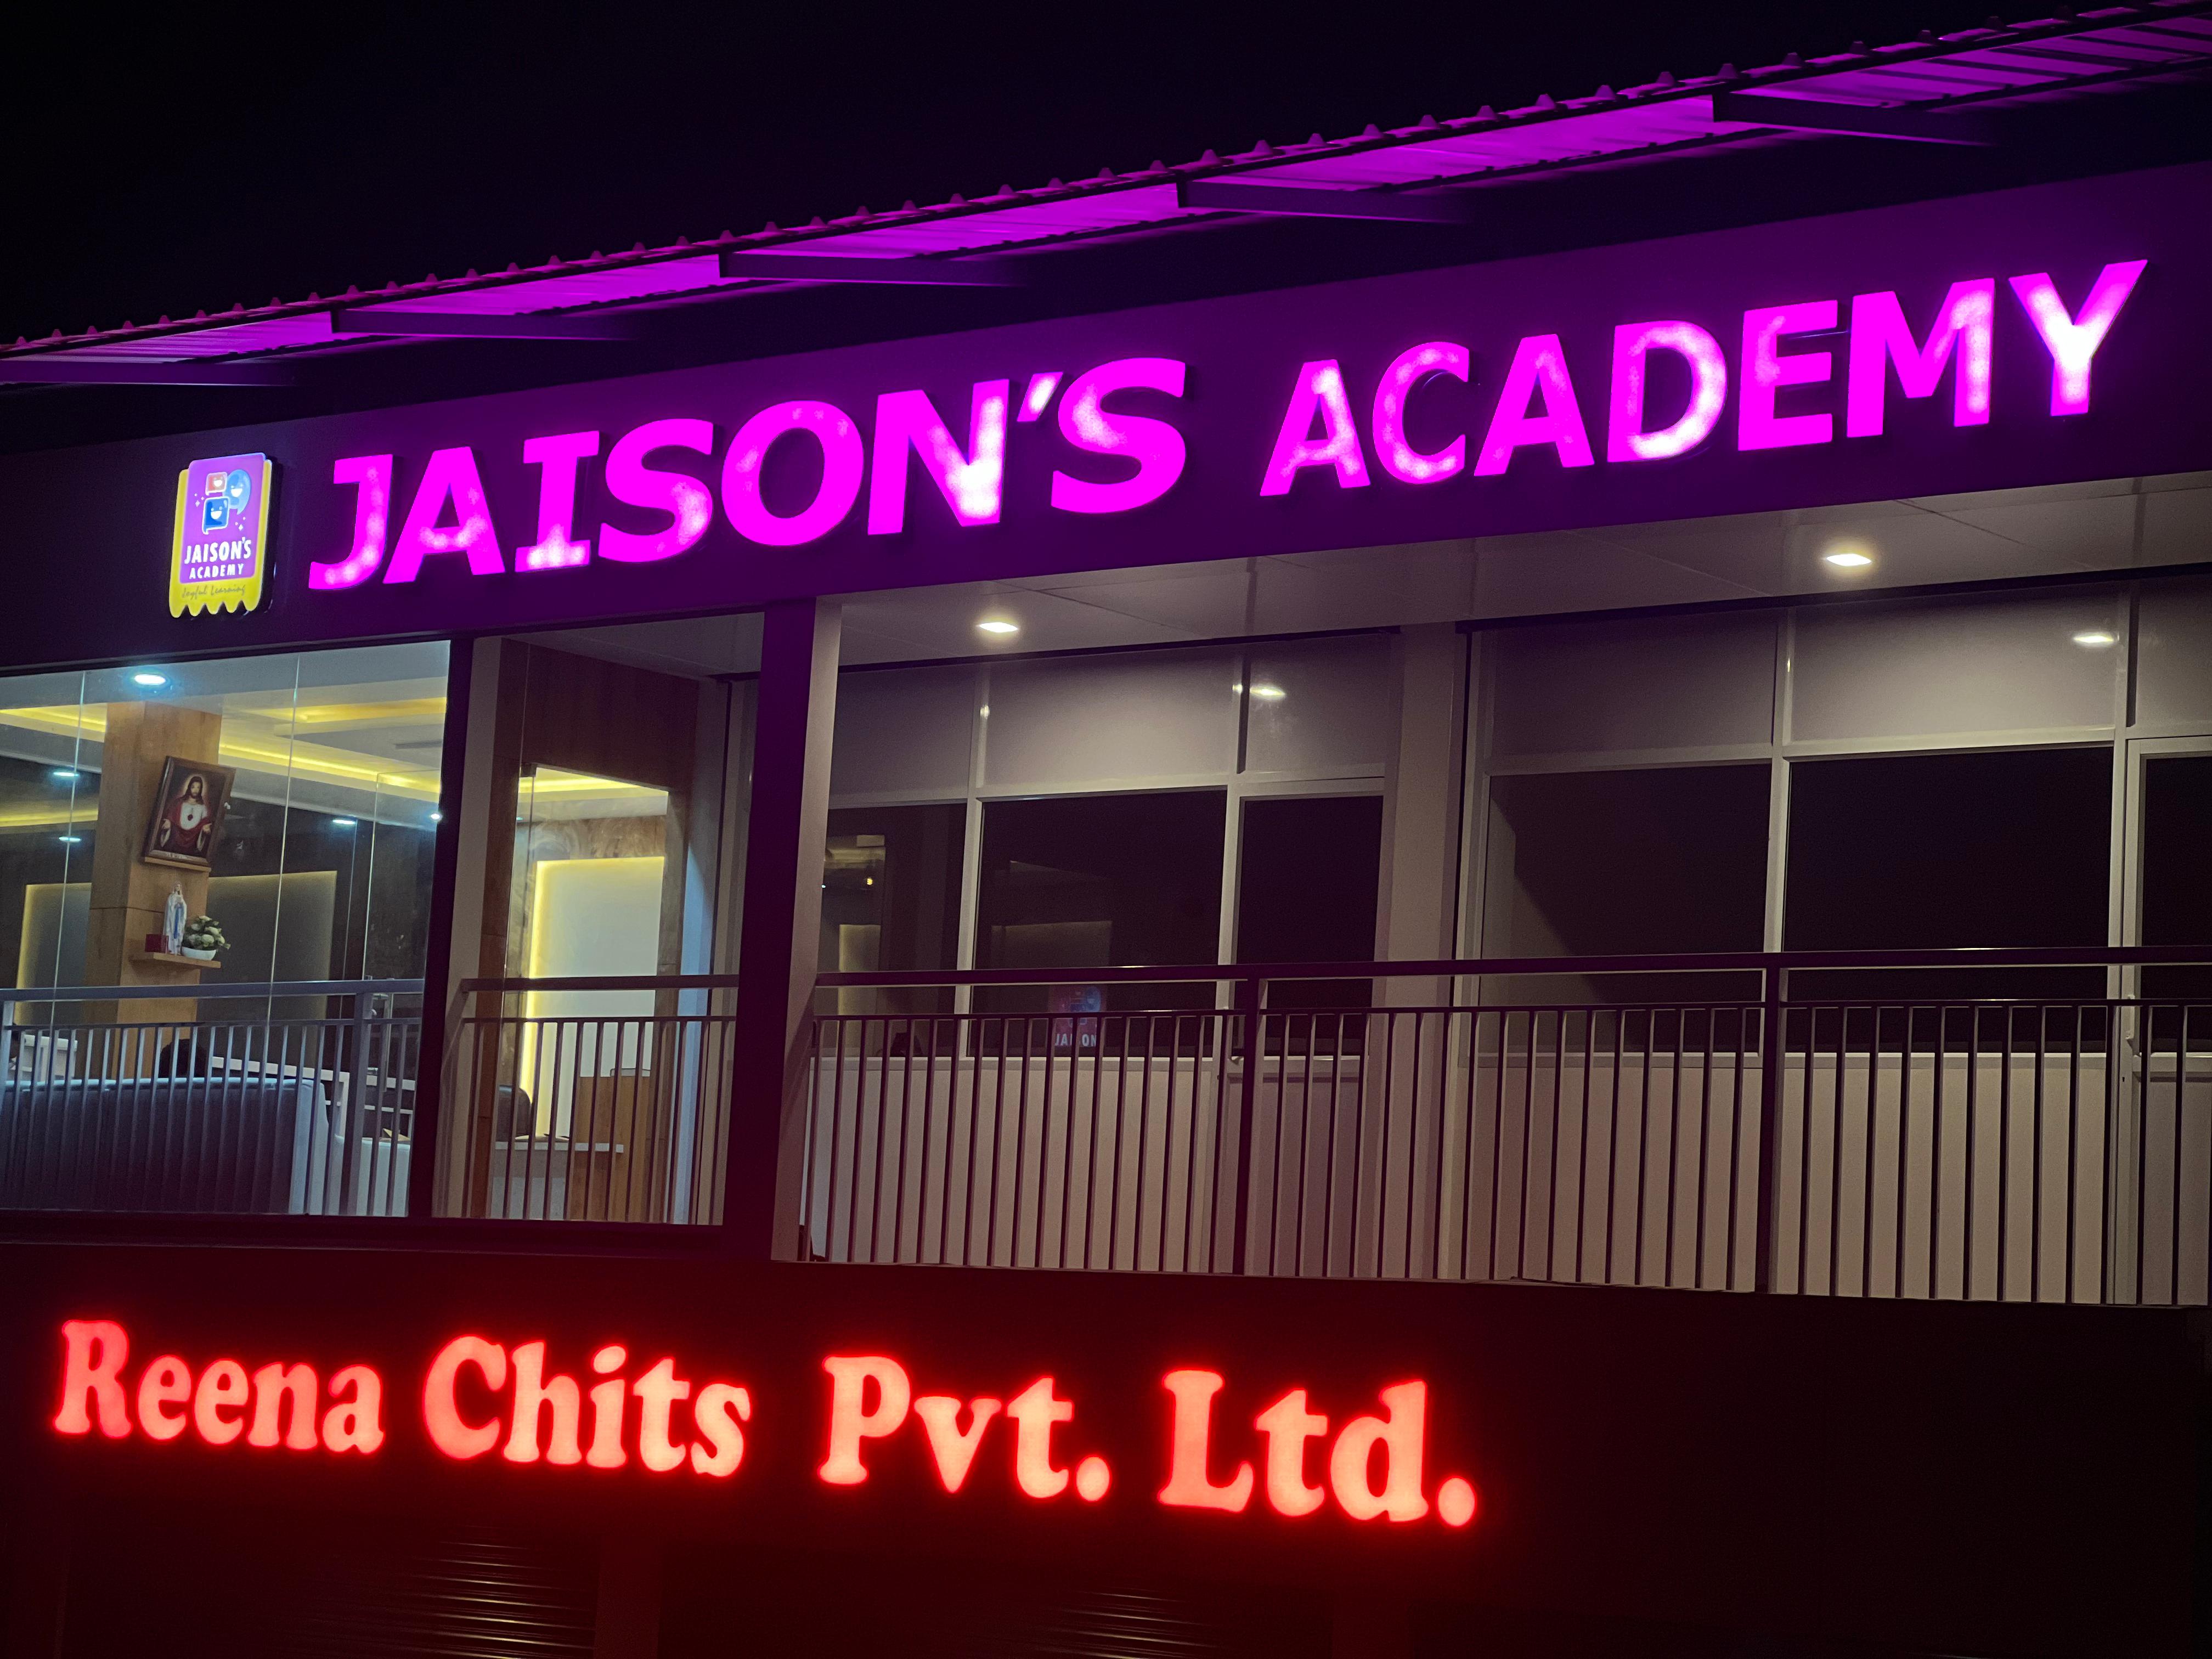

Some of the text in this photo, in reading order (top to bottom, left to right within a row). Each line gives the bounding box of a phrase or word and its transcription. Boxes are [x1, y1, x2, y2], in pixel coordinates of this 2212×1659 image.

[308, 259, 2148, 590] JAISON'S ACADEMY
[184, 537, 251, 564] JAISON'S
[189, 563, 244, 579] ACADEMY
[52, 1319, 1477, 1528] Reena Chits Pvt. Ltd.
